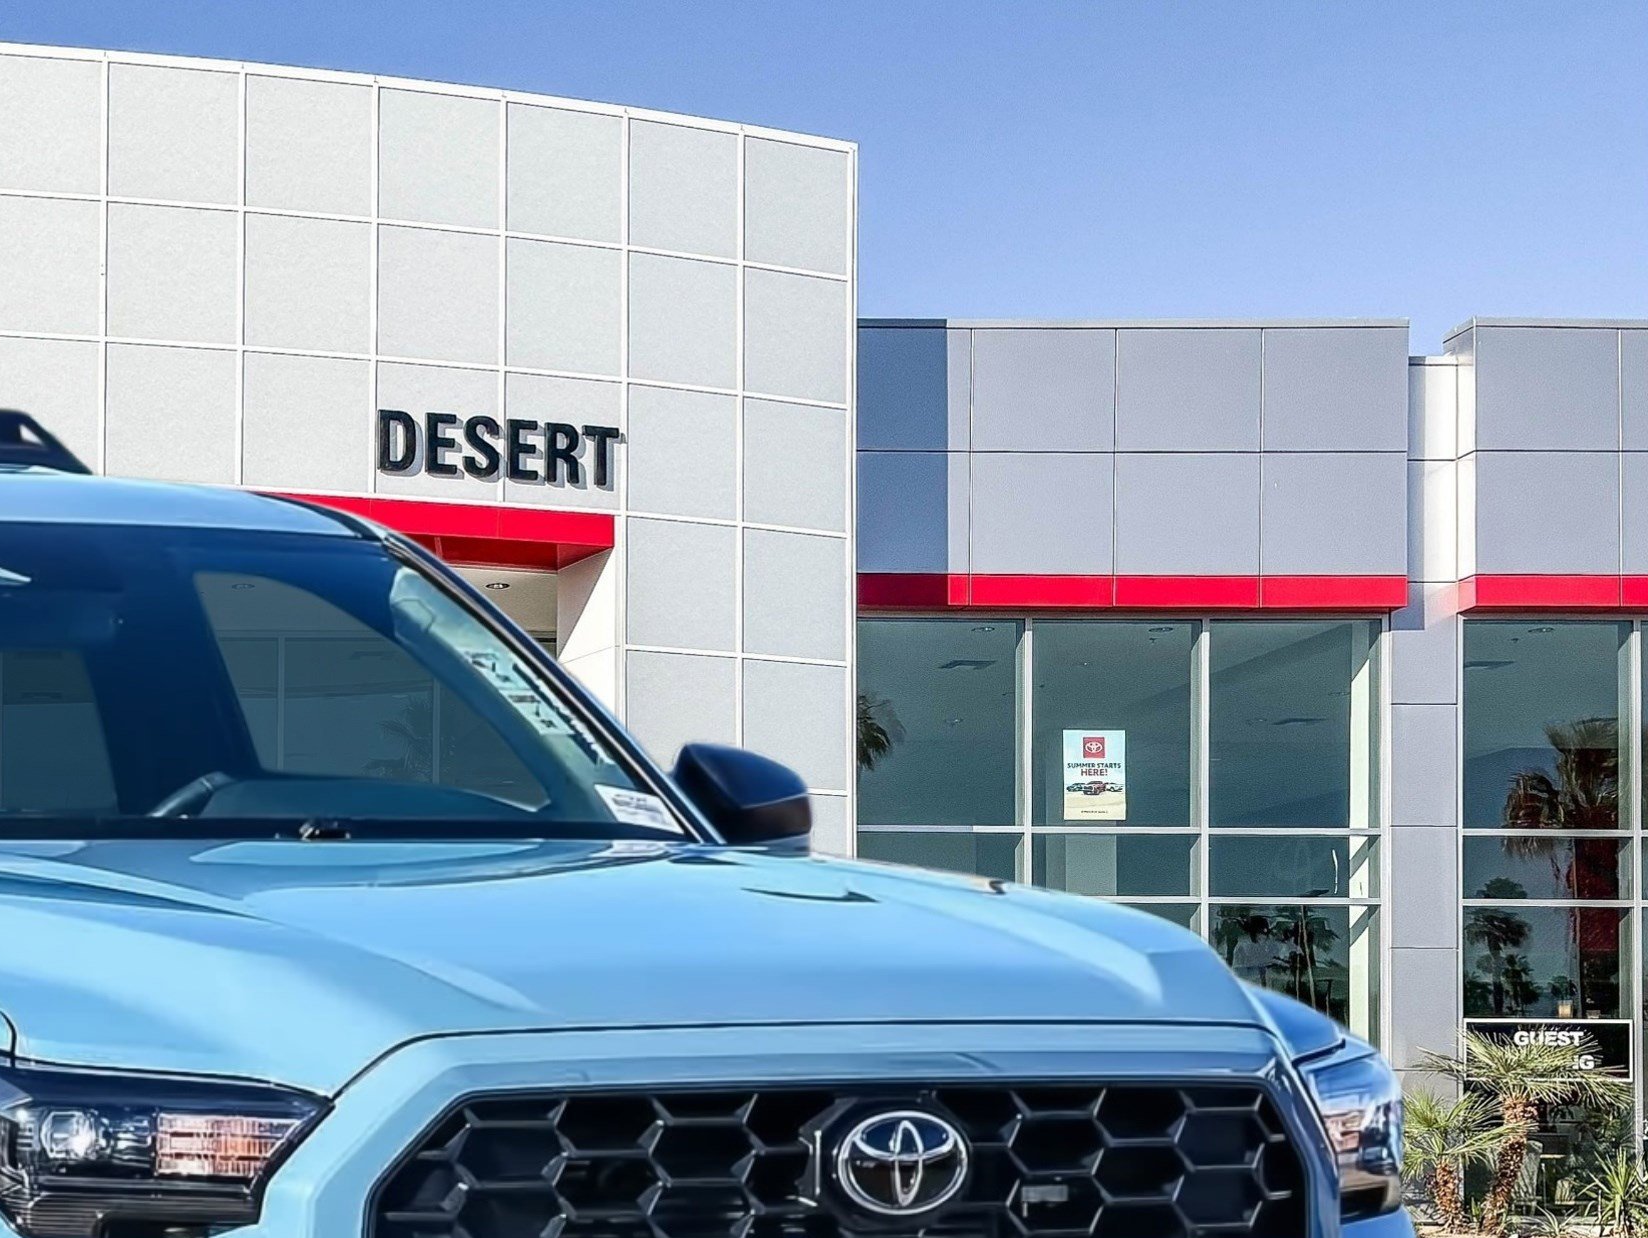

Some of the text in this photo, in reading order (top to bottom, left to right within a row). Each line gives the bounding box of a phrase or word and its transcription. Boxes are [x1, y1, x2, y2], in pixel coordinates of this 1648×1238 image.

[377, 409, 620, 487] DESERT
[1080, 768, 1108, 776] HERE!
[1513, 1030, 1585, 1047] GUEST
